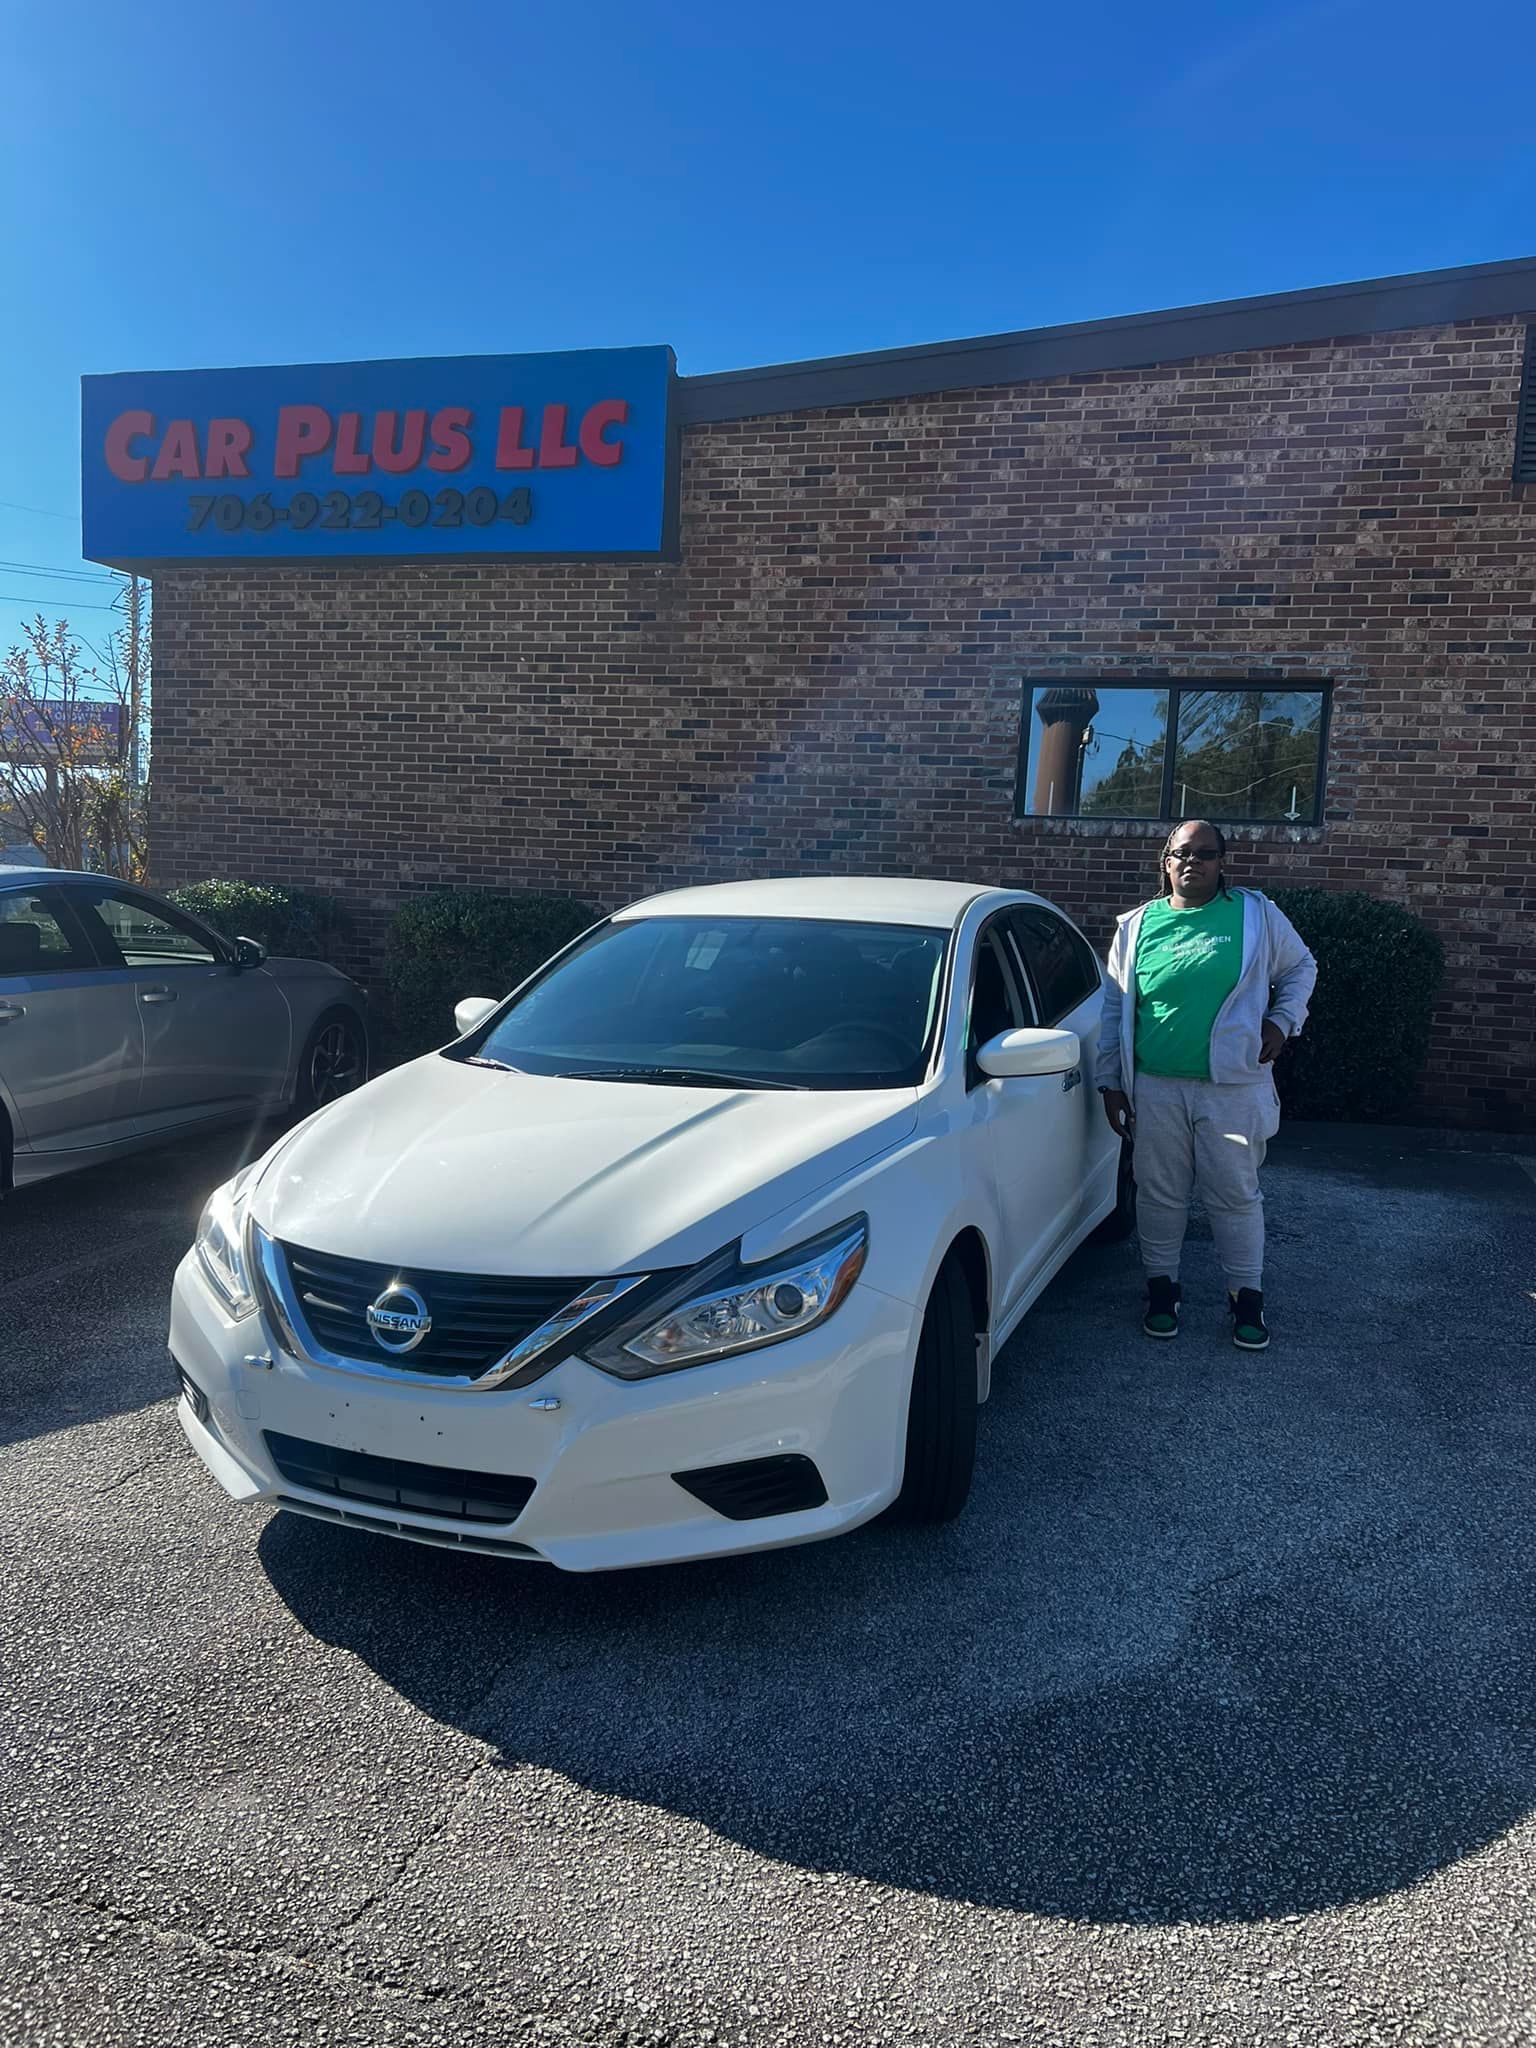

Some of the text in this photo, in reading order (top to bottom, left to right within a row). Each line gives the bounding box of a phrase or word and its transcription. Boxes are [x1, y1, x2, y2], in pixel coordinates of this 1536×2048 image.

[104, 399, 630, 482] CAR PLUS LLC
[186, 486, 533, 531] 706-922-0204
[371, 1312, 422, 1329] NISSAN
